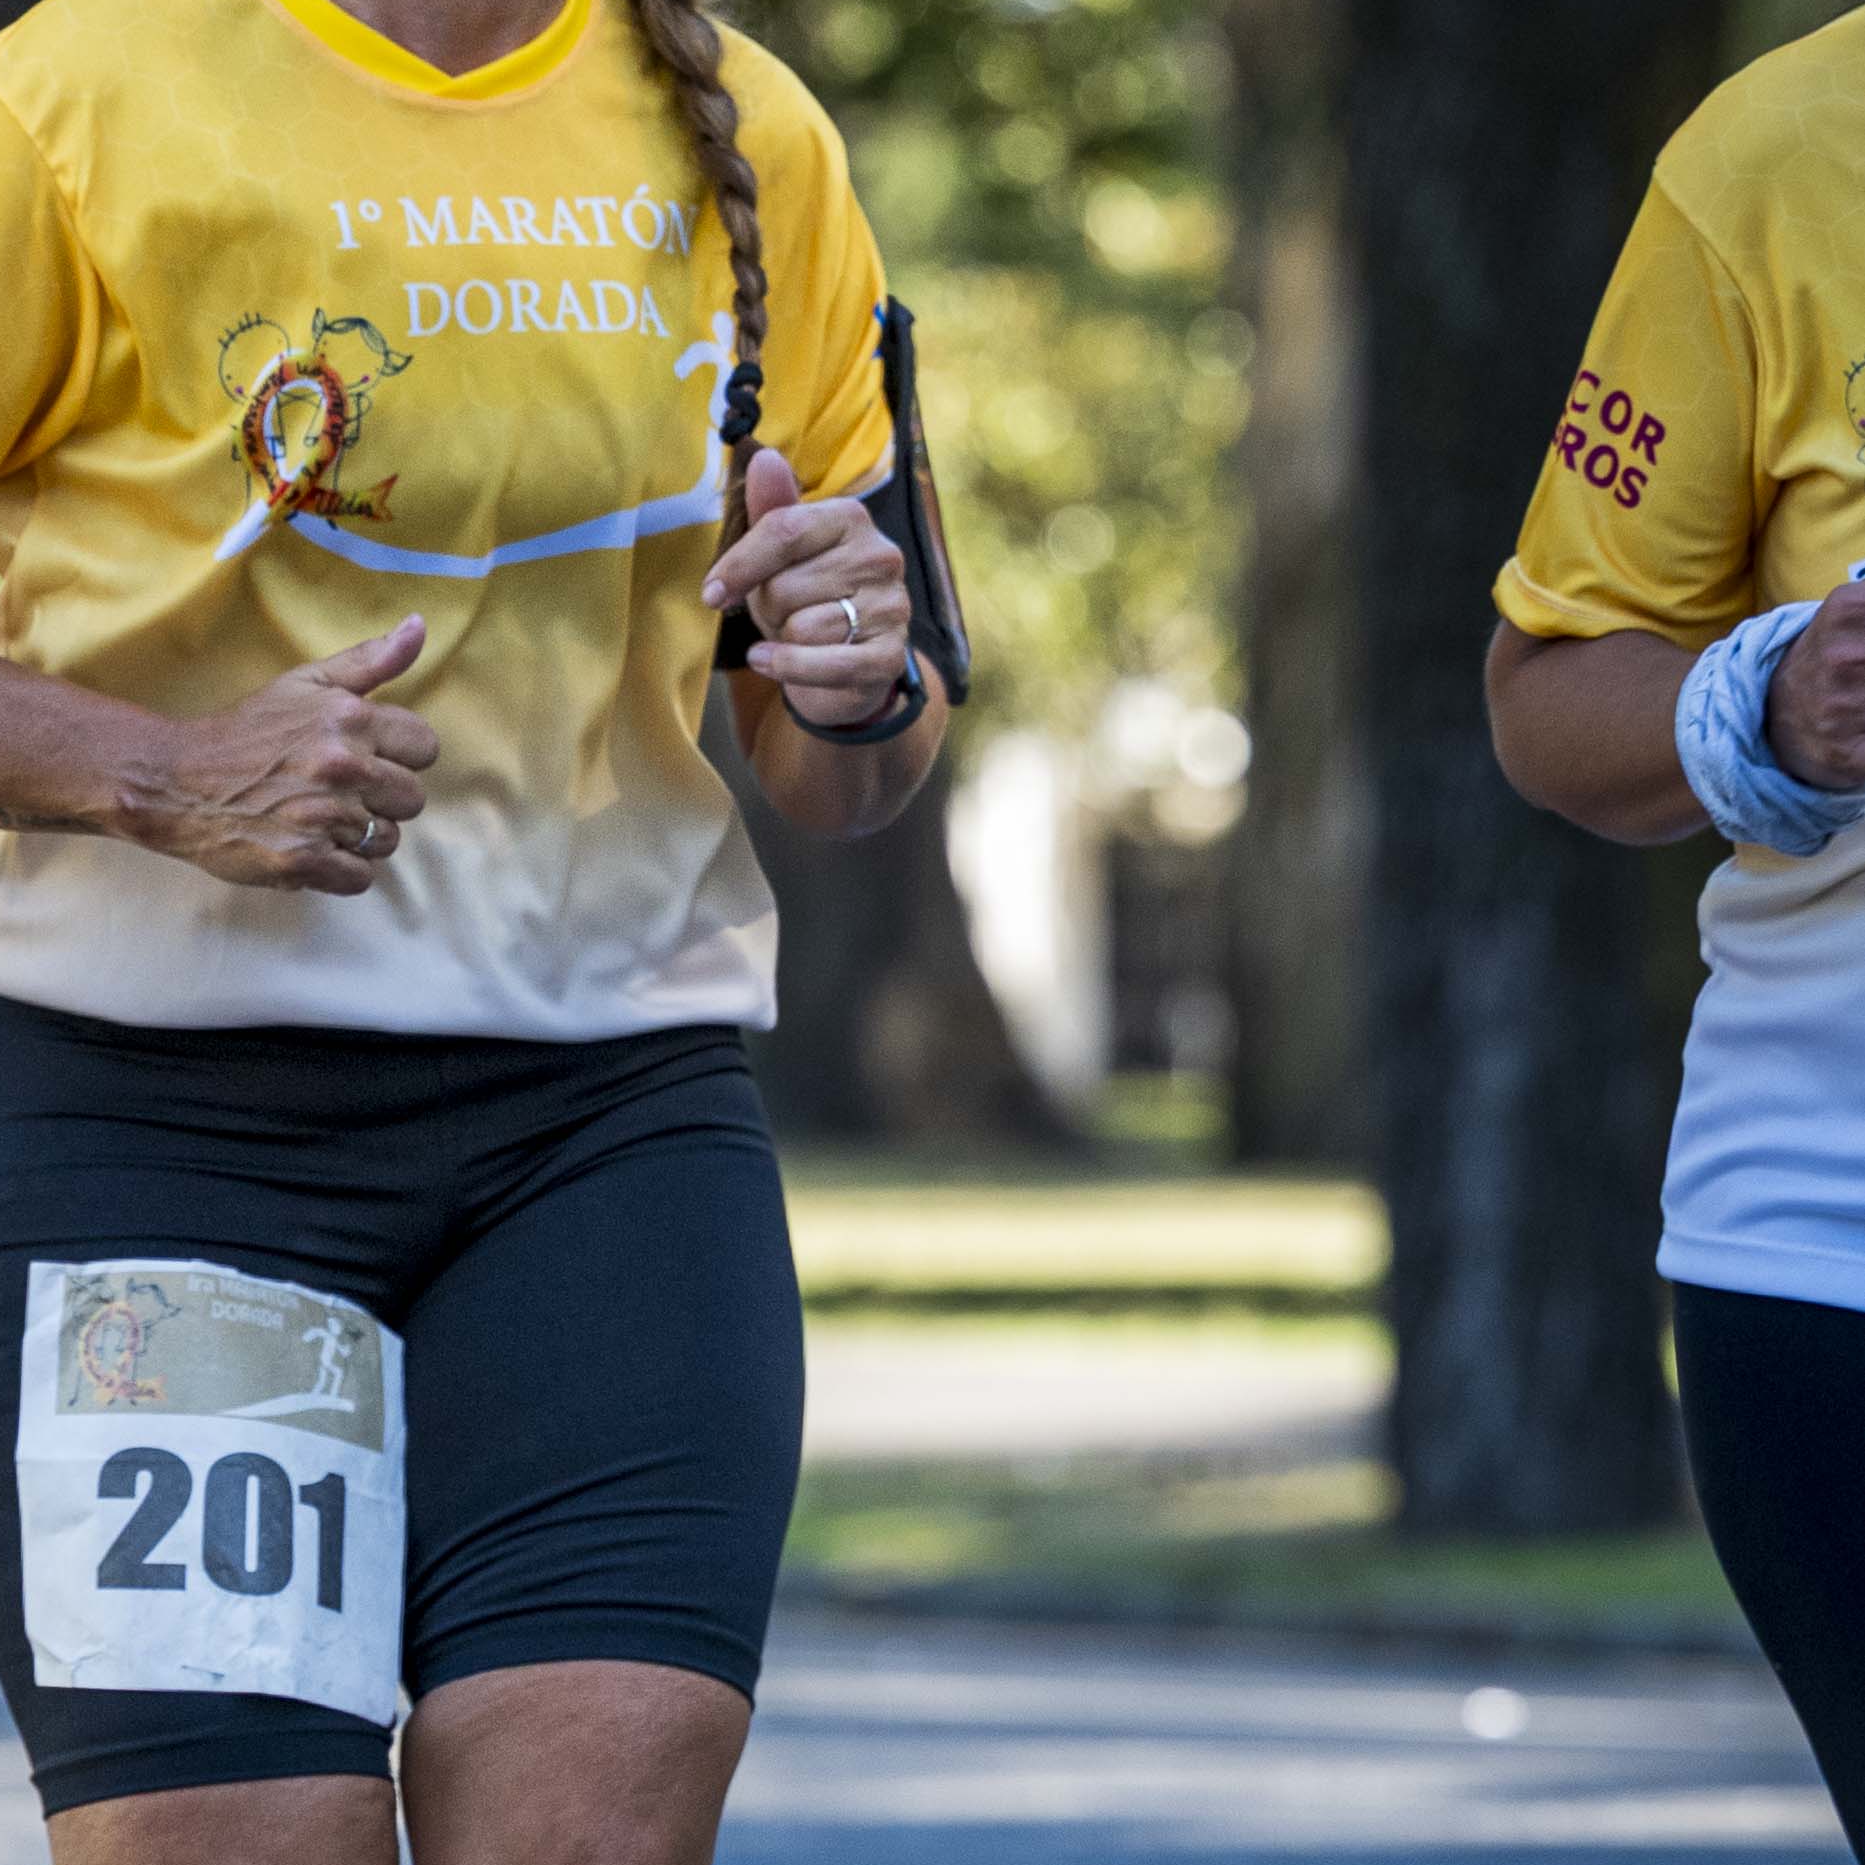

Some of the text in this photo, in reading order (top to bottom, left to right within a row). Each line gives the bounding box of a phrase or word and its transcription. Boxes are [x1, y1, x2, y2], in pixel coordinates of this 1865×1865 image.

[397, 183, 697, 256] MARATÓN
[403, 278, 672, 338] DORADA
[96, 1446, 346, 1614] 201
